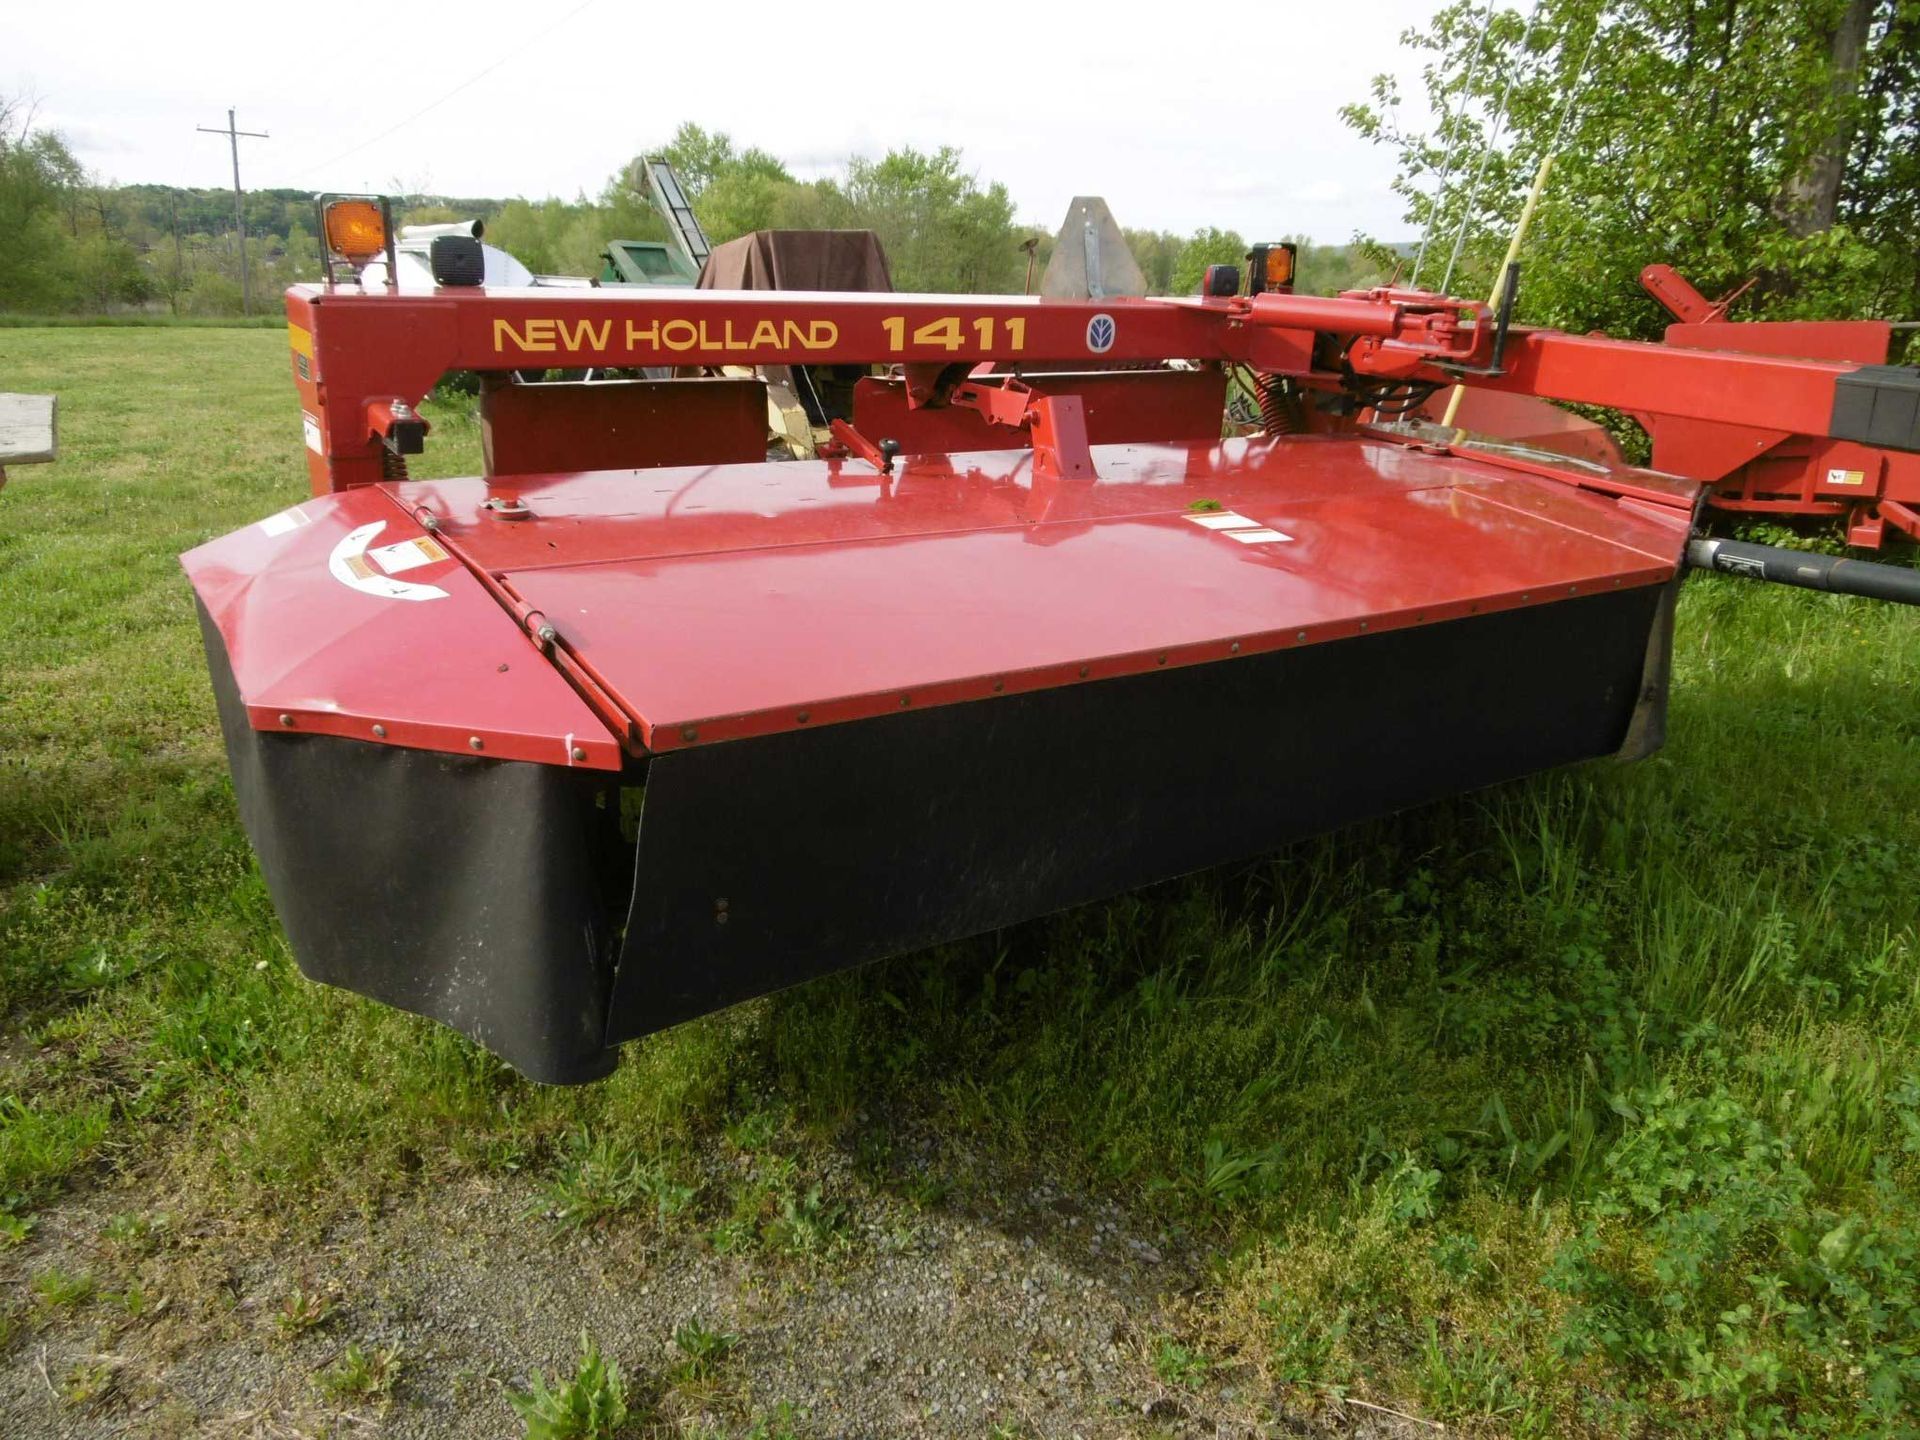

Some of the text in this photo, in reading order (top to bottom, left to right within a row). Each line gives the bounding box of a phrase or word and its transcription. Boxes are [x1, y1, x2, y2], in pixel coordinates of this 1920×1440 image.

[493, 316, 1026, 352] NEW HOLLAND 1411
